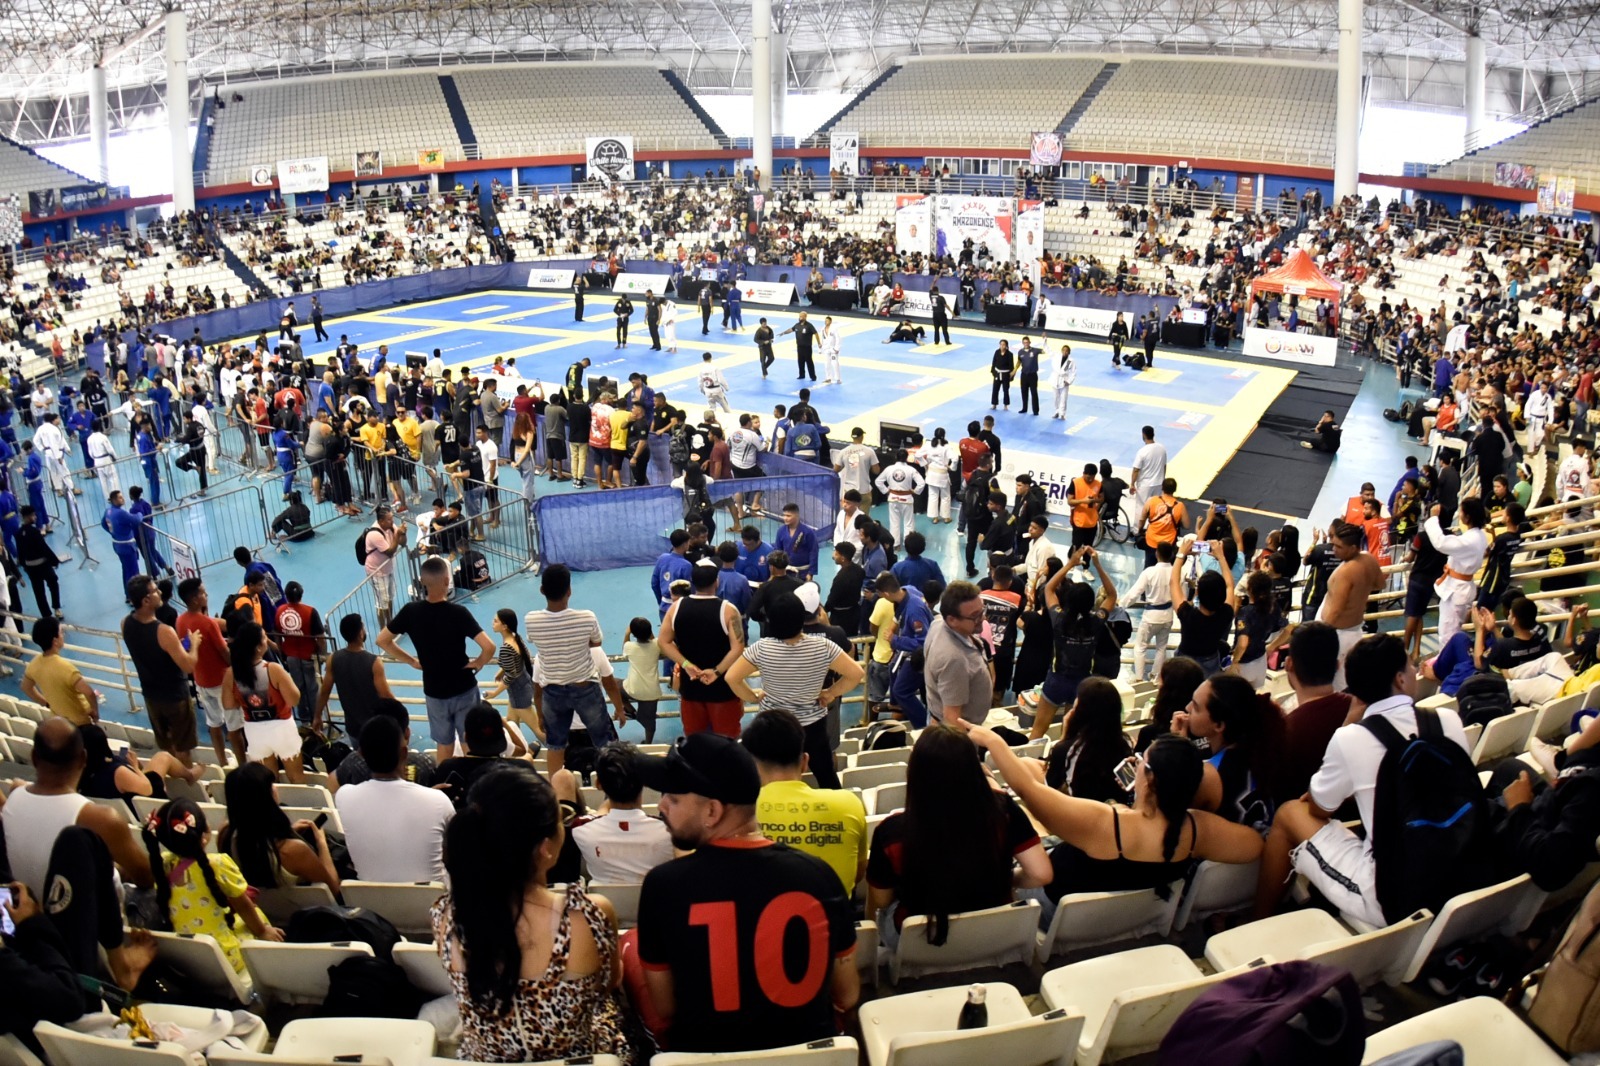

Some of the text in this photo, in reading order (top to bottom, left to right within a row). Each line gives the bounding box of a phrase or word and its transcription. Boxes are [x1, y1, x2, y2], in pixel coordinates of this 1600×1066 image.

[961, 202, 986, 212] XXXVI
[952, 216, 994, 228] AMAZONENSE
[444, 428, 456, 443] 20
[788, 821, 806, 832] do
[808, 821, 845, 832] Brasil.
[804, 833, 844, 847] digital.
[688, 891, 830, 1012] 10
